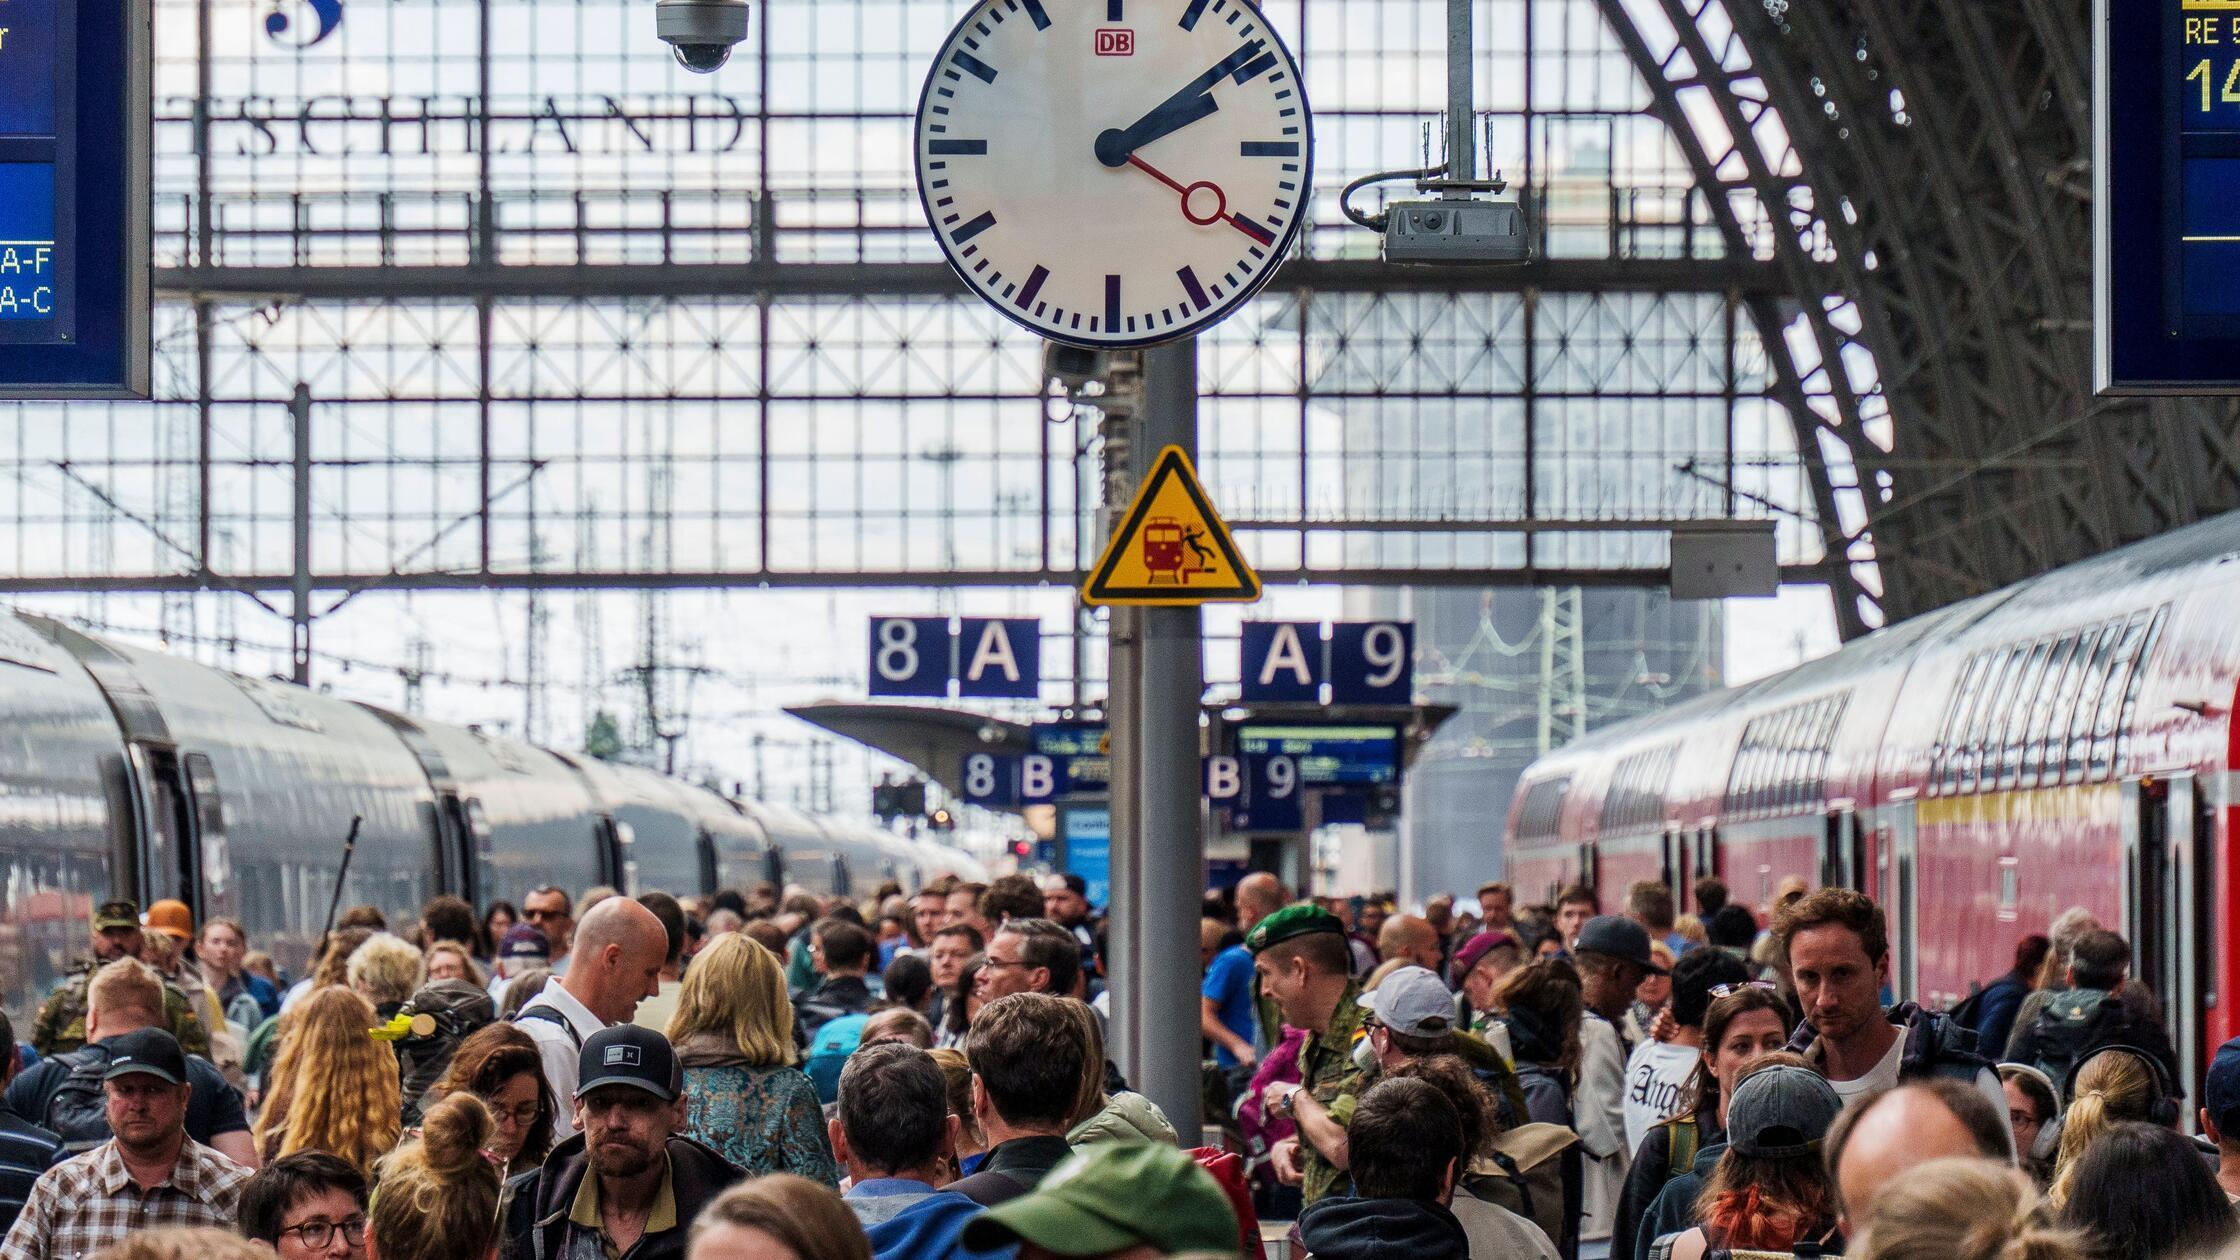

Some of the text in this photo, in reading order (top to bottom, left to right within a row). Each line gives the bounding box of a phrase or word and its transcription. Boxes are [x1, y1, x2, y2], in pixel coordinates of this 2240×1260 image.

[1100, 33, 1130, 52] DB
[2185, 17, 2219, 44] RE
[1, 247, 51, 274] A-F
[0, 286, 51, 313] A-C
[877, 618, 1021, 682] 8 A
[1258, 623, 1405, 688] A 9
[966, 754, 995, 797] 8
[1022, 755, 1054, 797] B
[1208, 755, 1240, 798] B
[1266, 755, 1296, 798] 9
